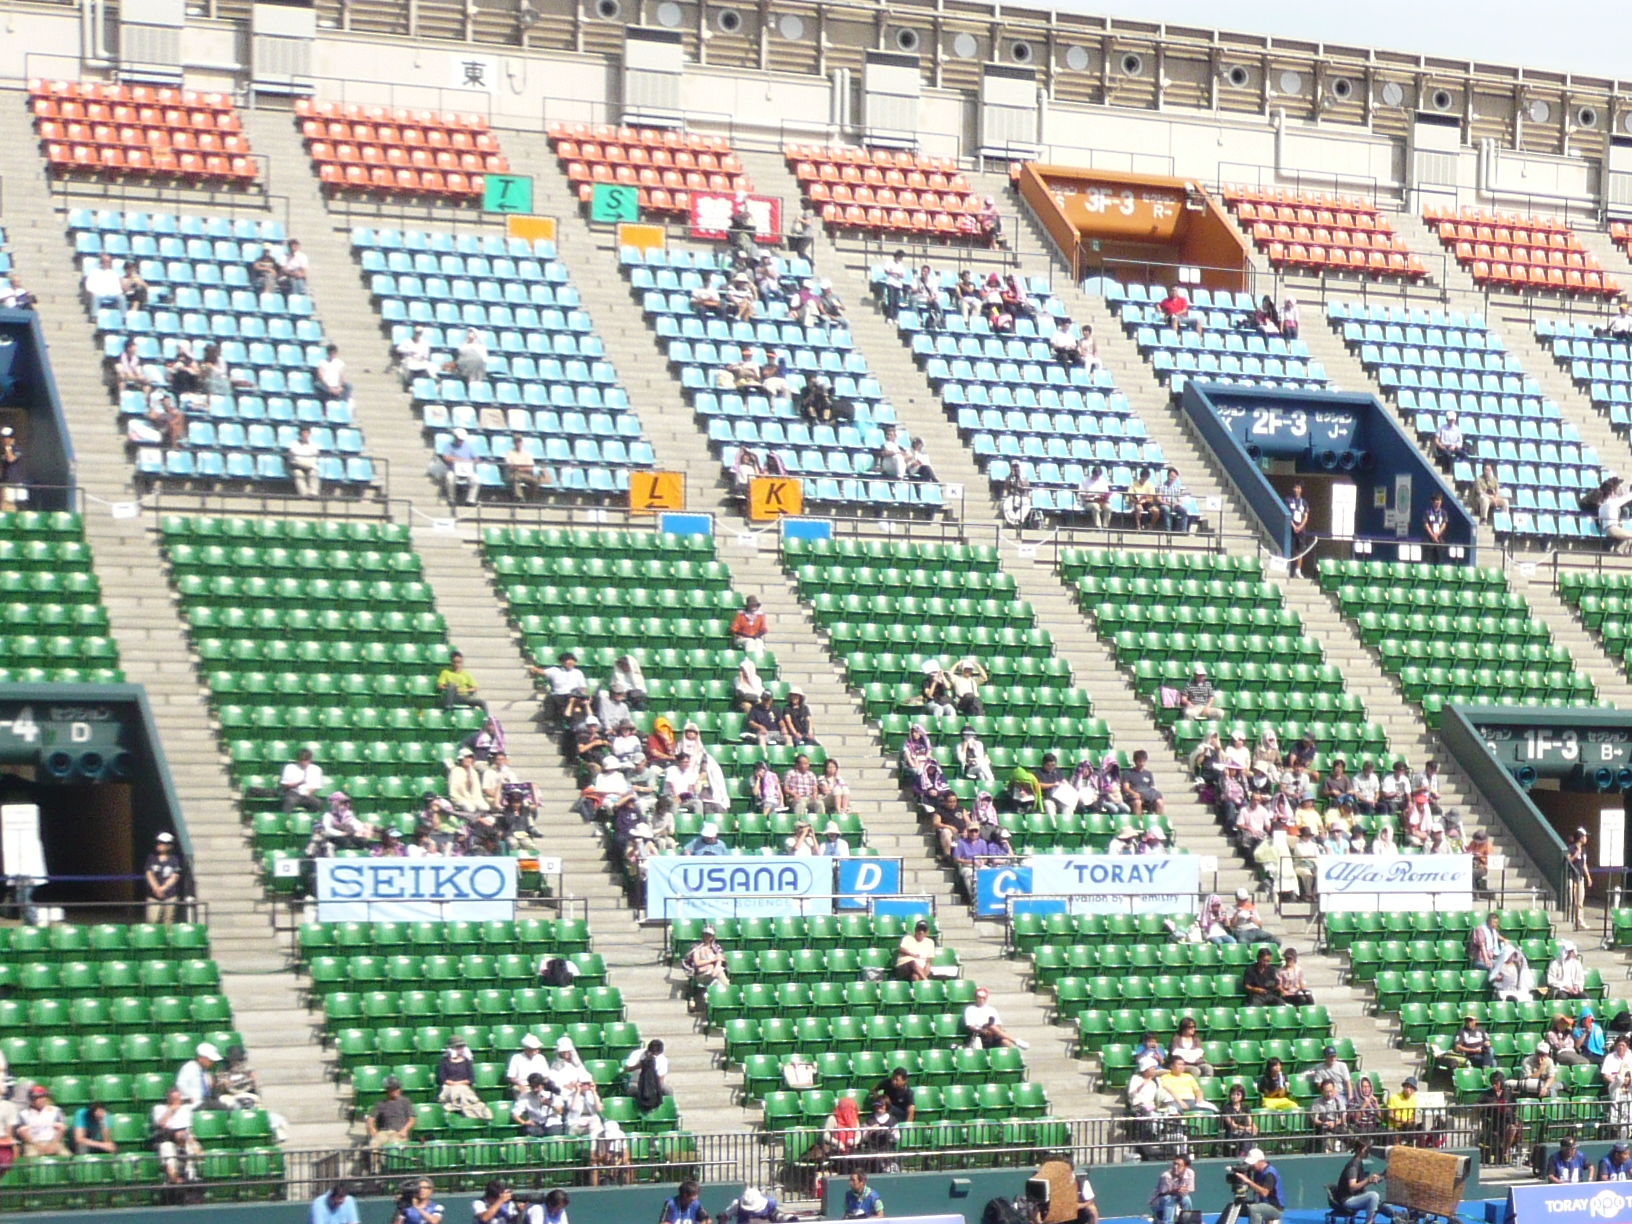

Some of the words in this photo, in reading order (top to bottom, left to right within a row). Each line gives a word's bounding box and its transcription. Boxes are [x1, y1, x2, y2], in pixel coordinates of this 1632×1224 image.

[461, 60, 487, 87] 東
[498, 179, 515, 199] T
[605, 189, 624, 209] S
[1085, 187, 1135, 216] 3F-3
[1153, 204, 1164, 218] R
[1252, 408, 1307, 437] 2F-3
[1328, 425, 1339, 439] J
[648, 477, 664, 500] L
[765, 483, 788, 505] K
[71, 722, 92, 742] D
[1523, 729, 1579, 760] 1F-3
[1601, 744, 1614, 760] B
[328, 864, 506, 899] SEIKO
[682, 866, 799, 892] USANA
[854, 863, 882, 892] D
[993, 870, 1018, 899] C
[1324, 861, 1384, 891] Alfa
[1384, 860, 1467, 883] Romeo
[1544, 1198, 1588, 1214] TORAY
